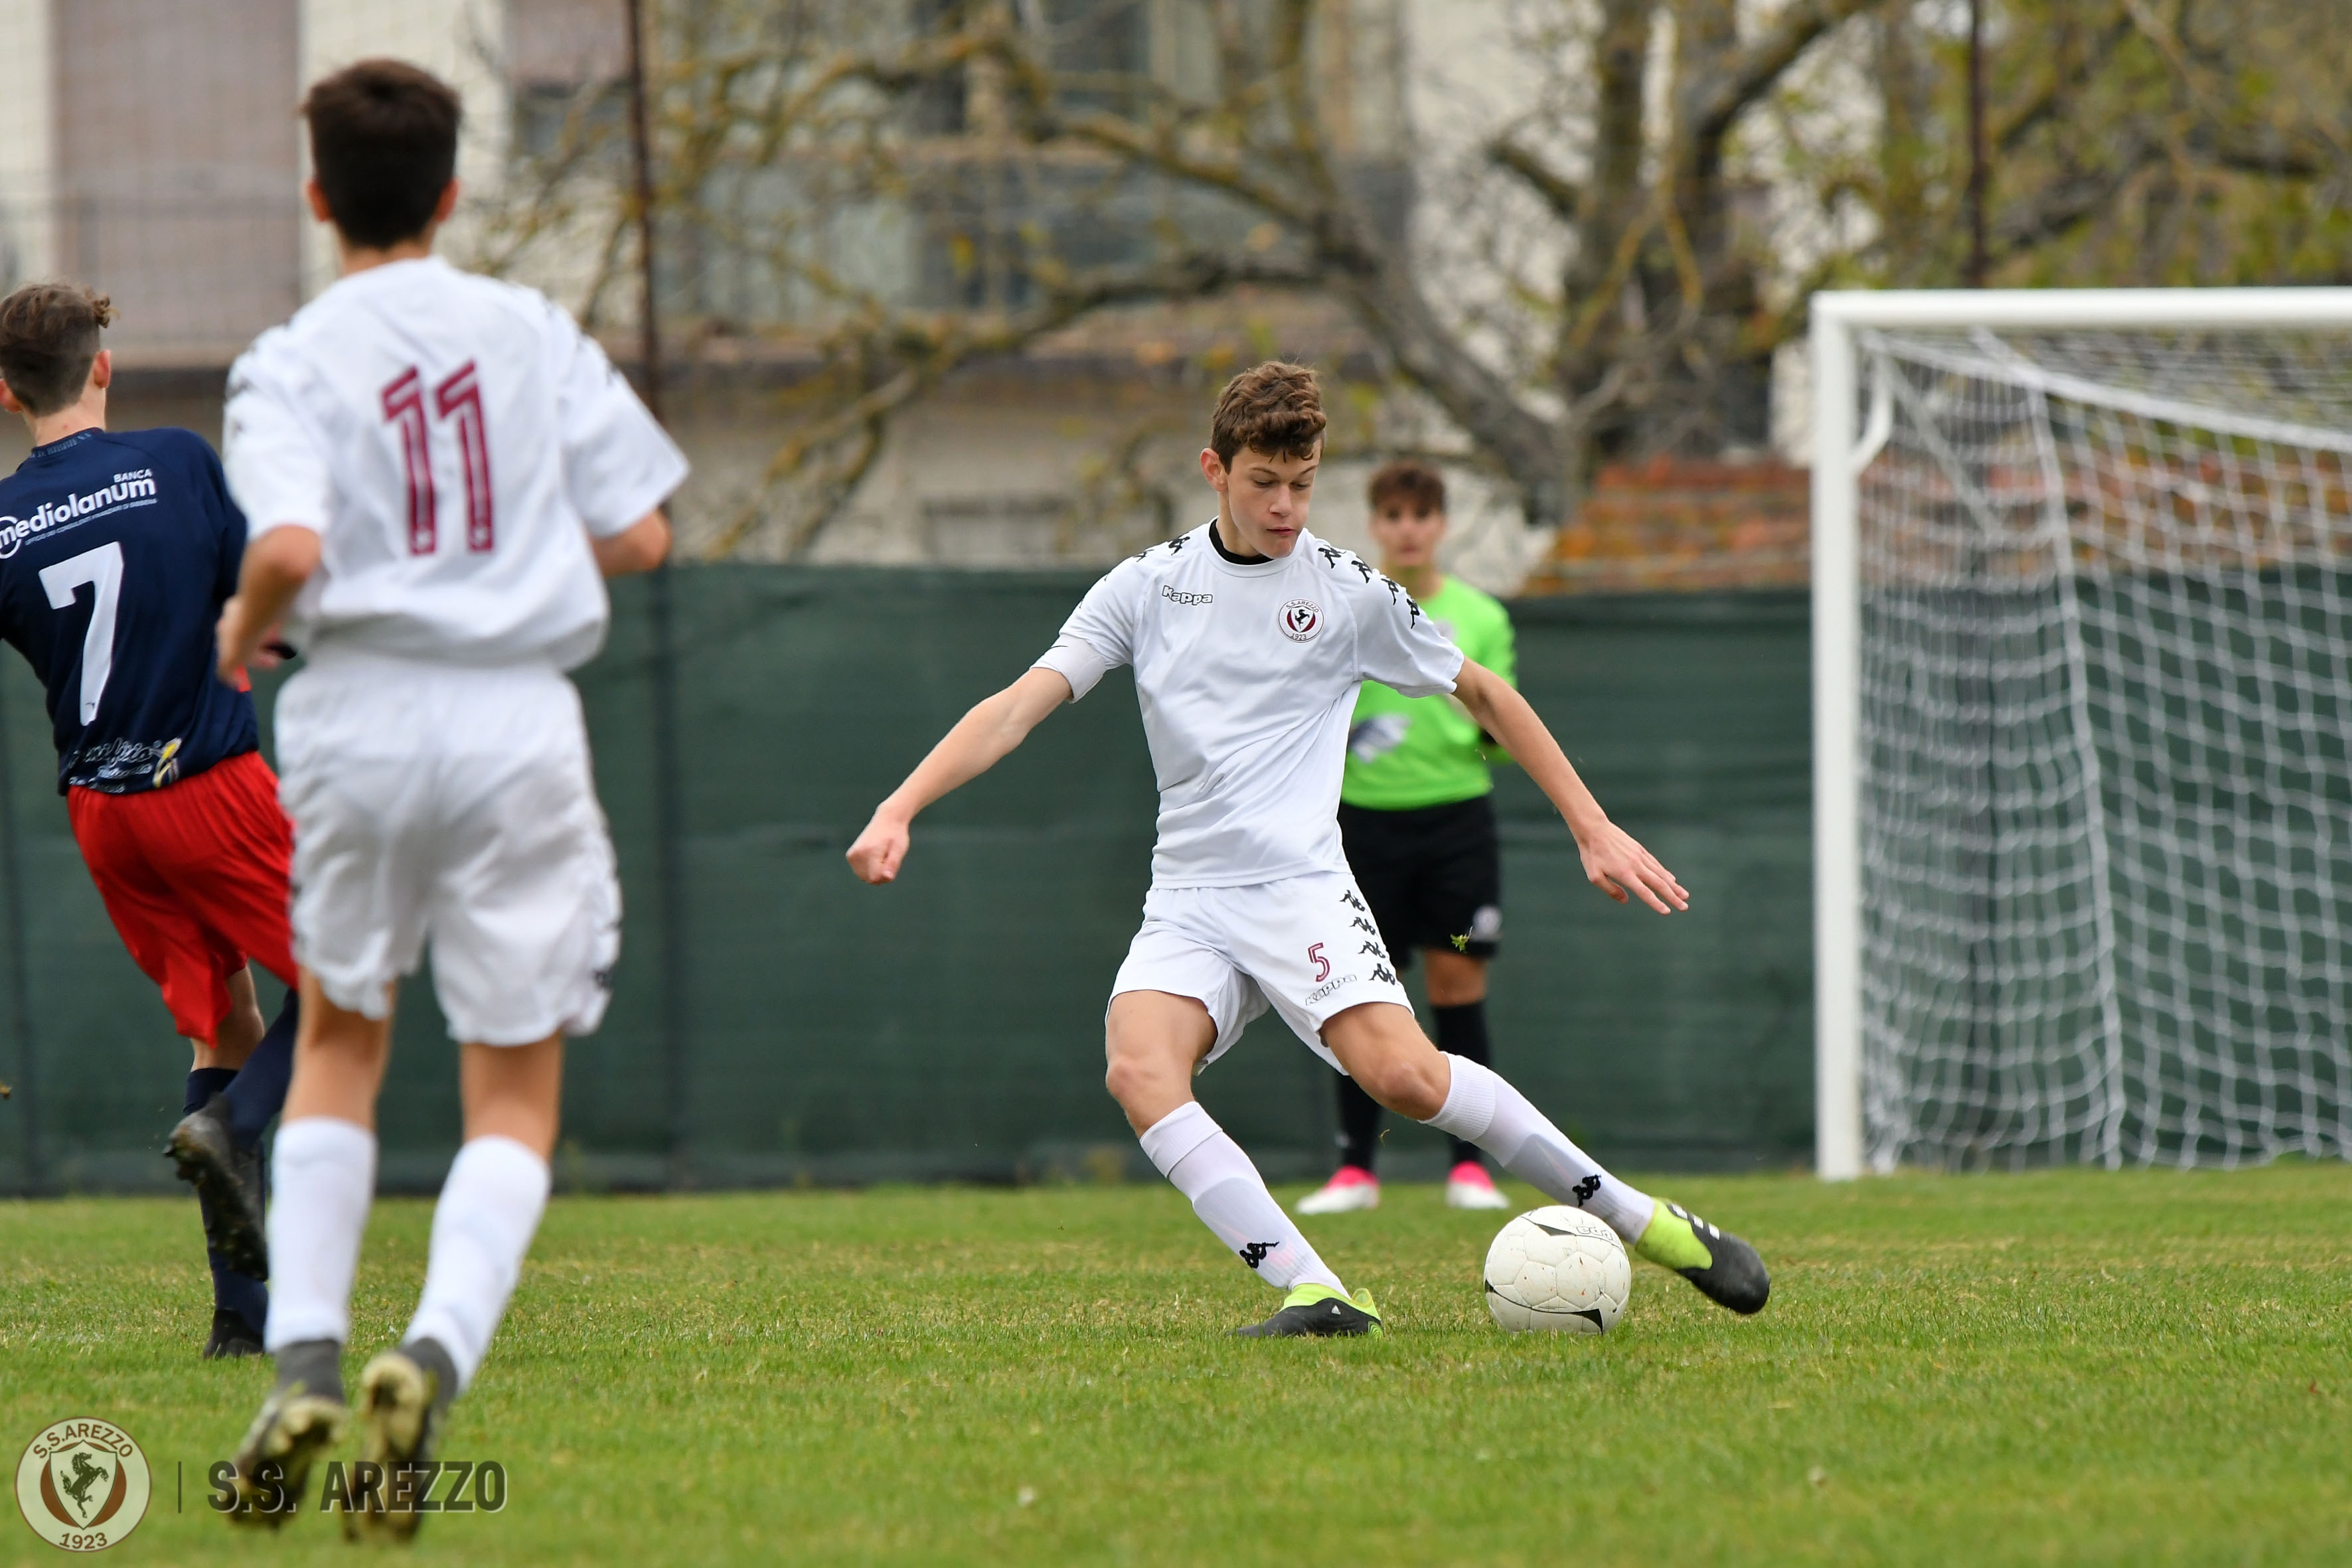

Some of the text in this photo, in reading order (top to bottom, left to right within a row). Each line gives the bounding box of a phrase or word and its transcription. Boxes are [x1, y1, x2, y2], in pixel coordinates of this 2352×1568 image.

[113, 468, 153, 483] BANCA
[380, 359, 494, 556] 11
[0, 478, 157, 549] mediolanum
[1162, 585, 1214, 606] Kappa
[39, 541, 124, 726] 7
[1308, 942, 1330, 982] 5
